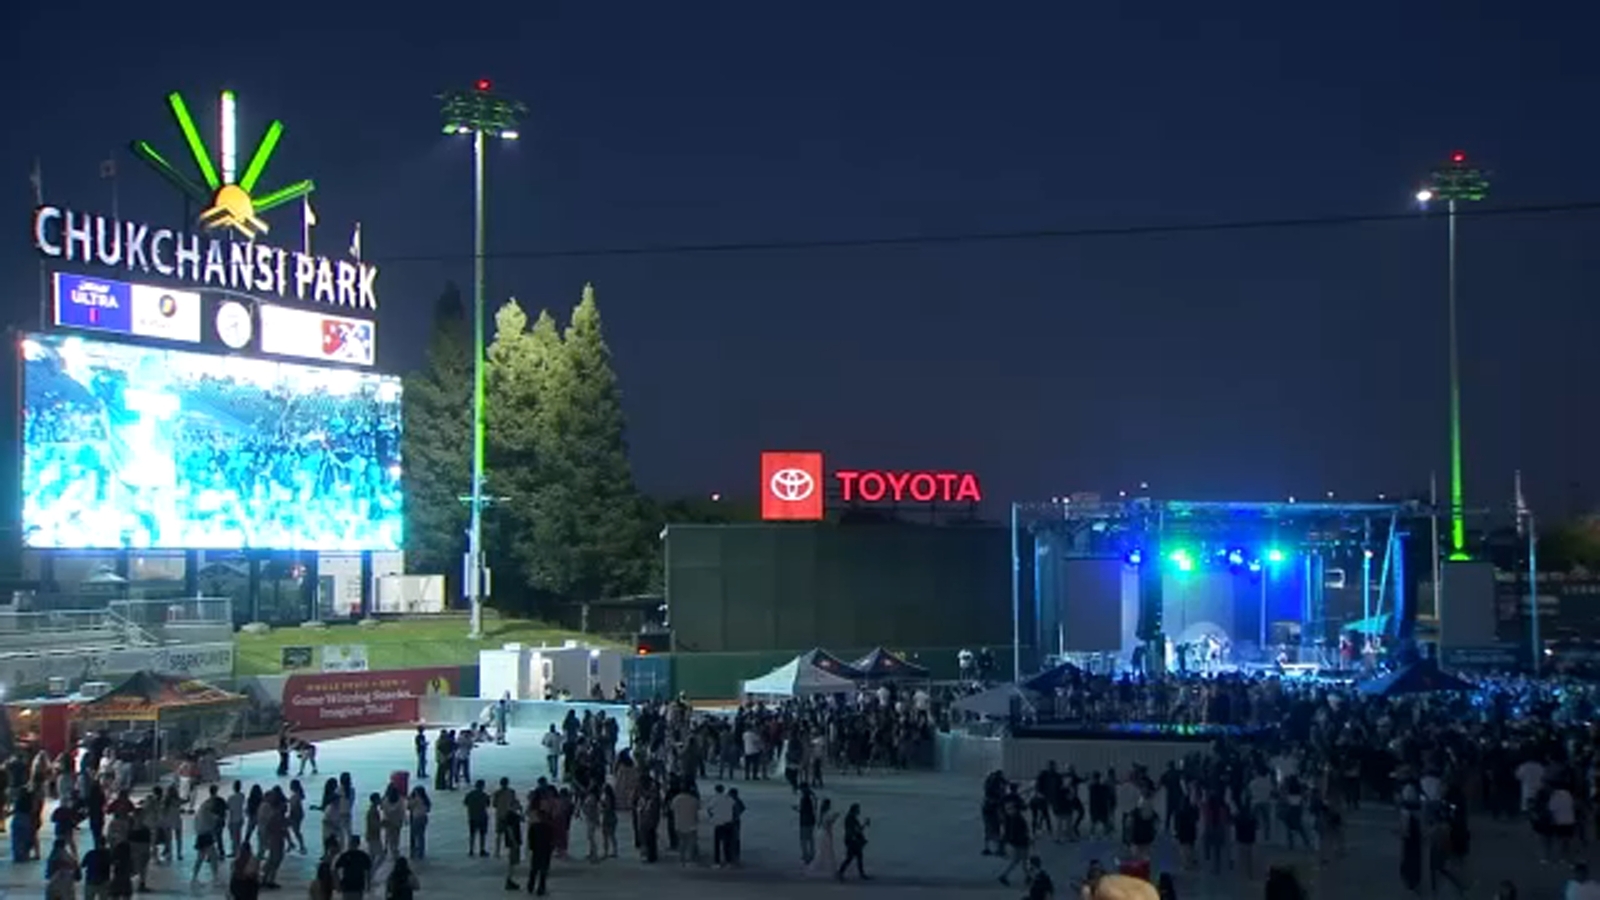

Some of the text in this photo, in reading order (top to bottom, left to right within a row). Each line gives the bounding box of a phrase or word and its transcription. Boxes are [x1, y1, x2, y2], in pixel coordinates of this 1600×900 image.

[37, 206, 377, 309] CHUKCHANSI PARK
[71, 289, 119, 308] ULTRA
[836, 472, 981, 501] TOYOTA
[292, 694, 324, 706] Game
[325, 690, 371, 704] Winning
[319, 706, 363, 719] Imagine
